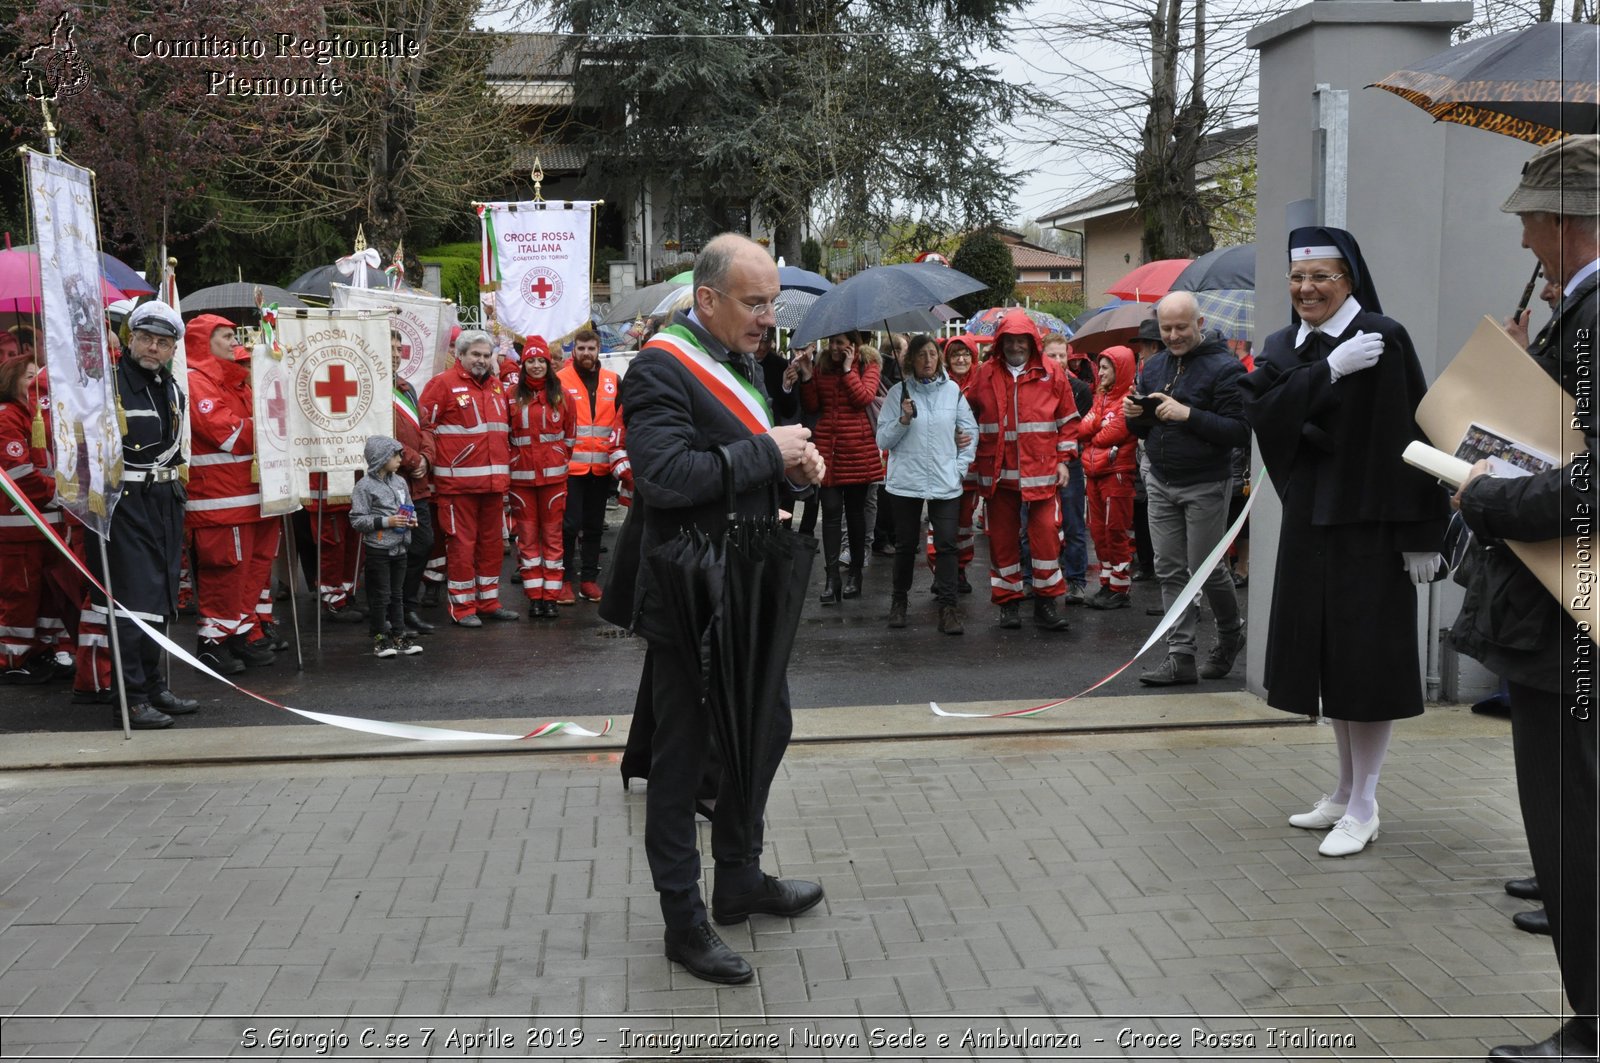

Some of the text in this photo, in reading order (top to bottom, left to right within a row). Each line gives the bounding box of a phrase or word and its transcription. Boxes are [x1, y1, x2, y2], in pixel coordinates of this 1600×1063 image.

[504, 232, 575, 242] CROCE ROSSA
[518, 243, 562, 253] ITALIANA
[405, 311, 432, 338] ITALIANA
[407, 327, 415, 337] 22
[414, 338, 423, 364] AGOSTO
[288, 329, 388, 381] OCE ROSSA ITALIANA
[310, 355, 320, 366] DI
[356, 364, 368, 376] 22
[298, 367, 331, 428] CONVENZIONE
[359, 378, 372, 412] AGOSTO
[294, 435, 368, 446] COMITATO LOCAL
[263, 459, 289, 470] COMITAT
[293, 454, 365, 467] ASTELLAMO
